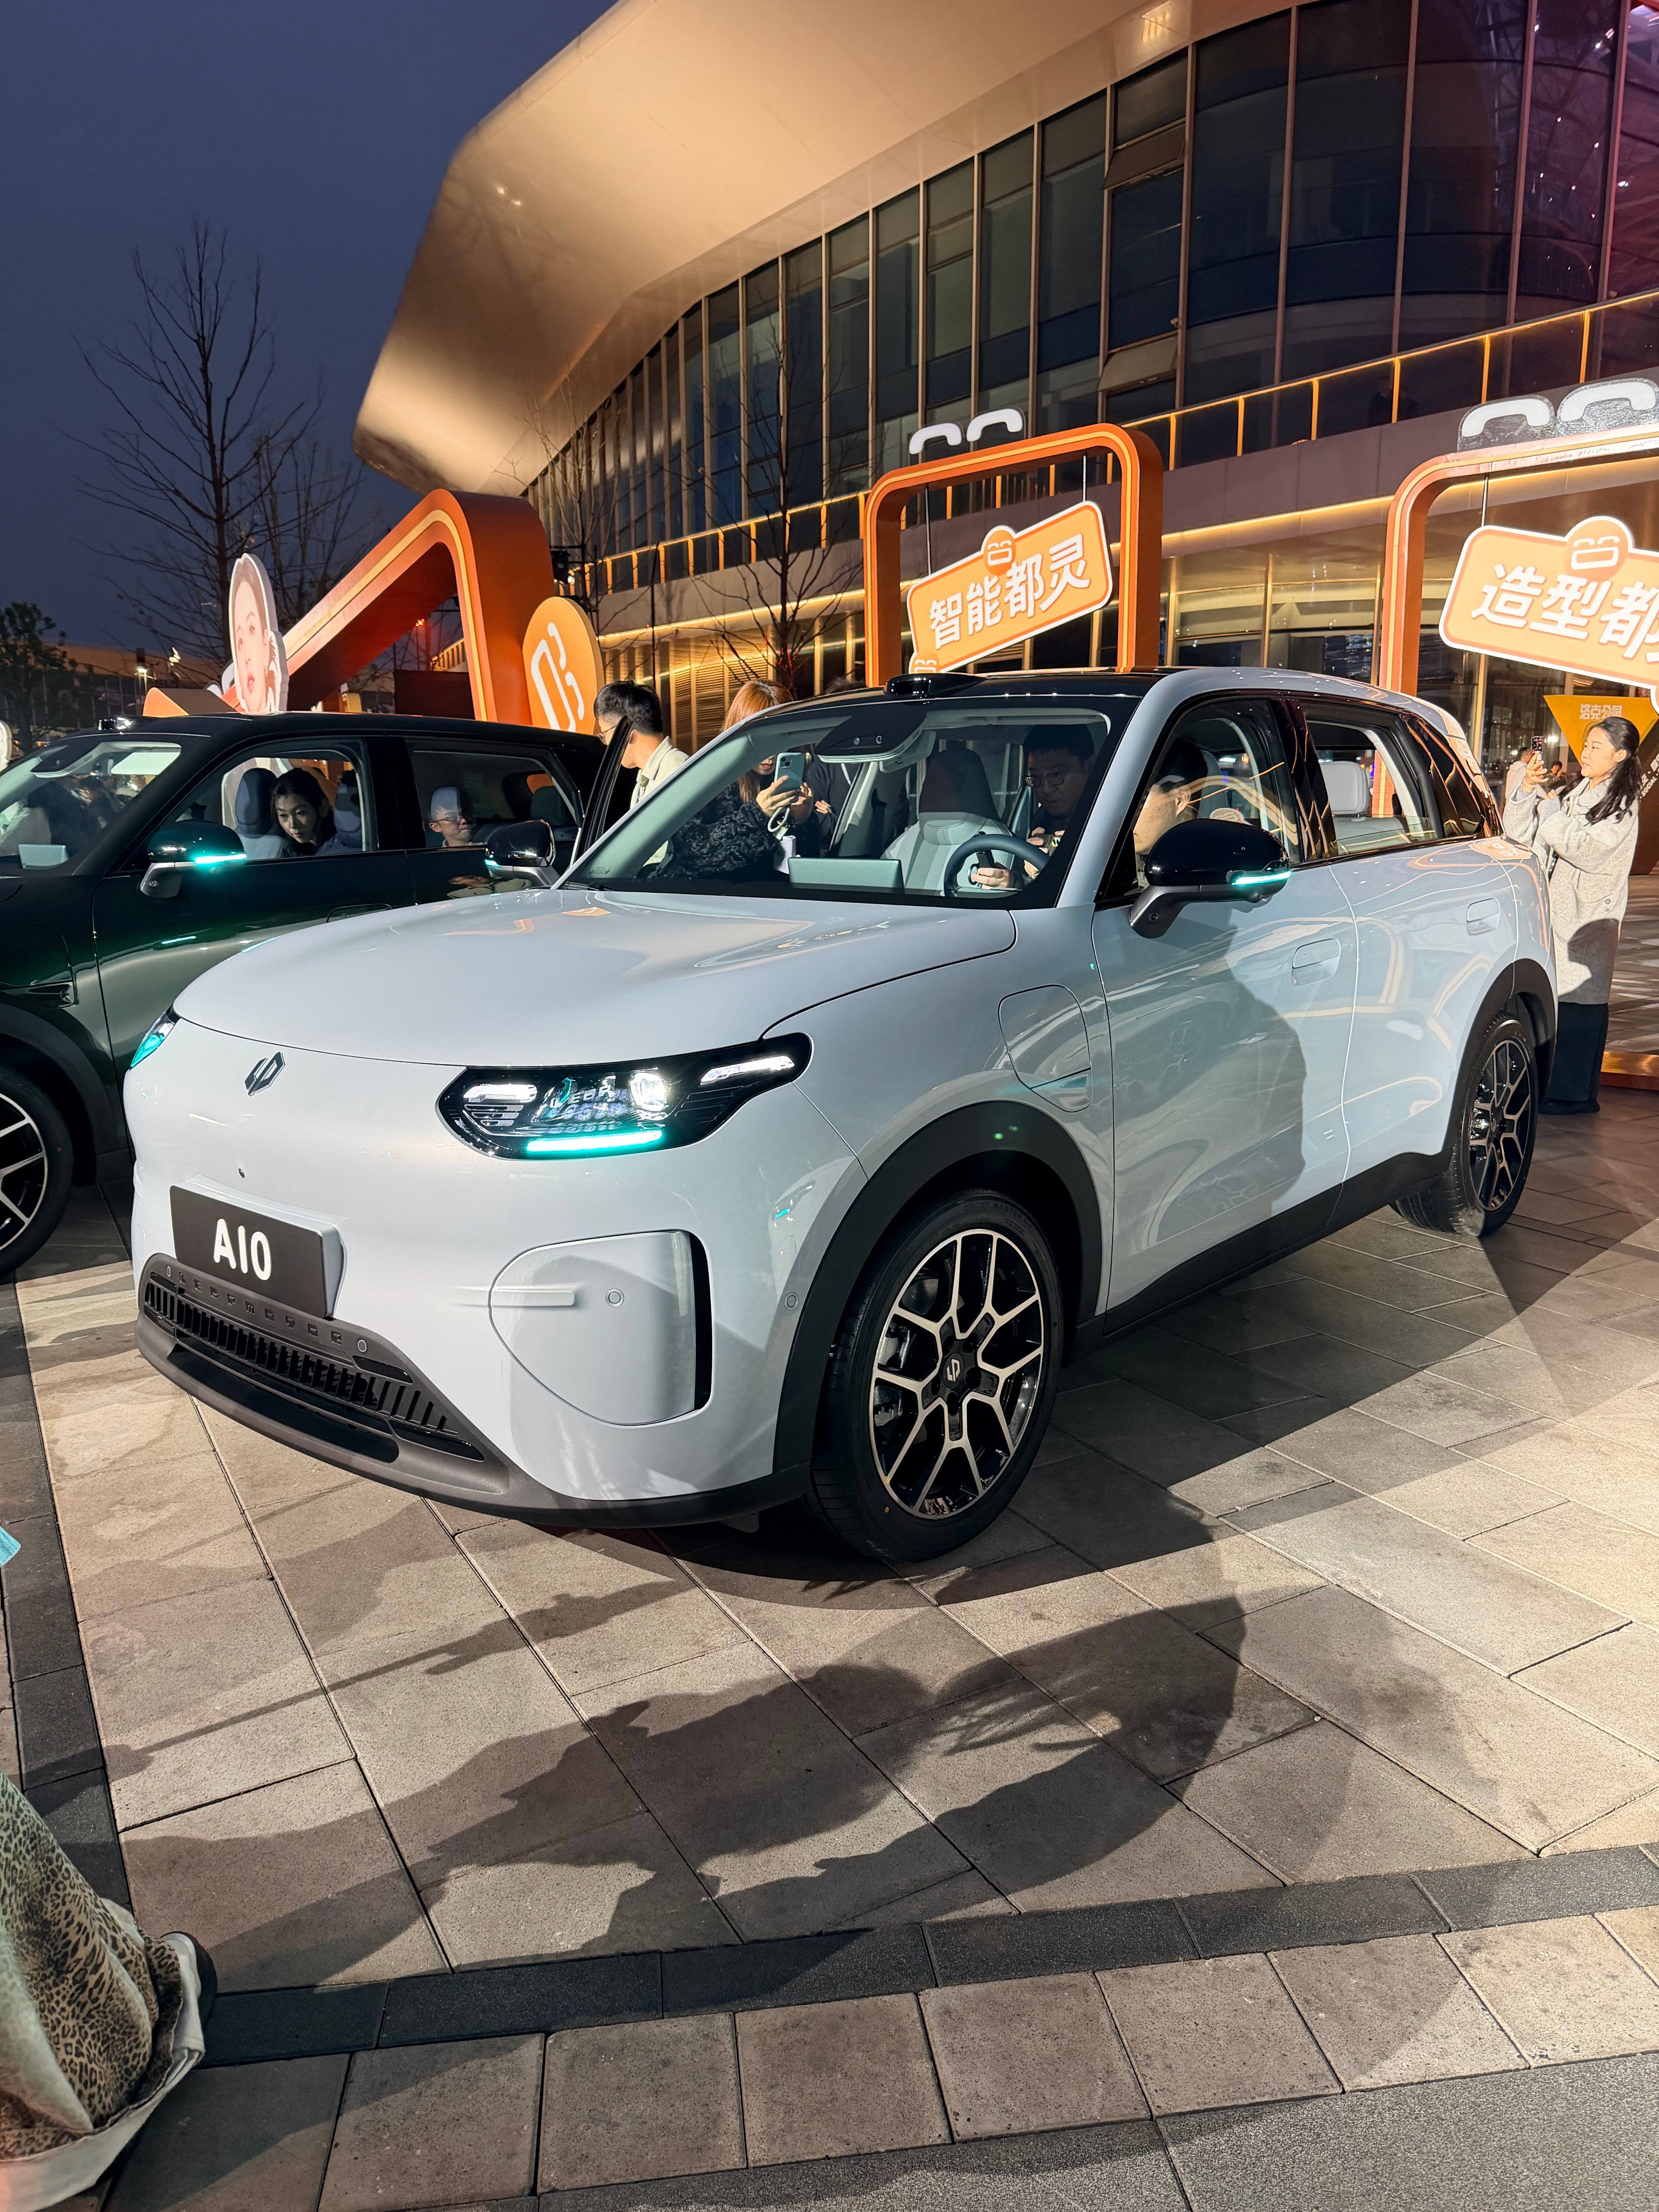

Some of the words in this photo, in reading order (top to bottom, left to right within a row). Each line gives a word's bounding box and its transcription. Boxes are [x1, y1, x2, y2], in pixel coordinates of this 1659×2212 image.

[929, 533, 1090, 650] 智能都灵
[1471, 564, 1659, 663] 造型都
[1642, 776, 1657, 797] SOCIAL
